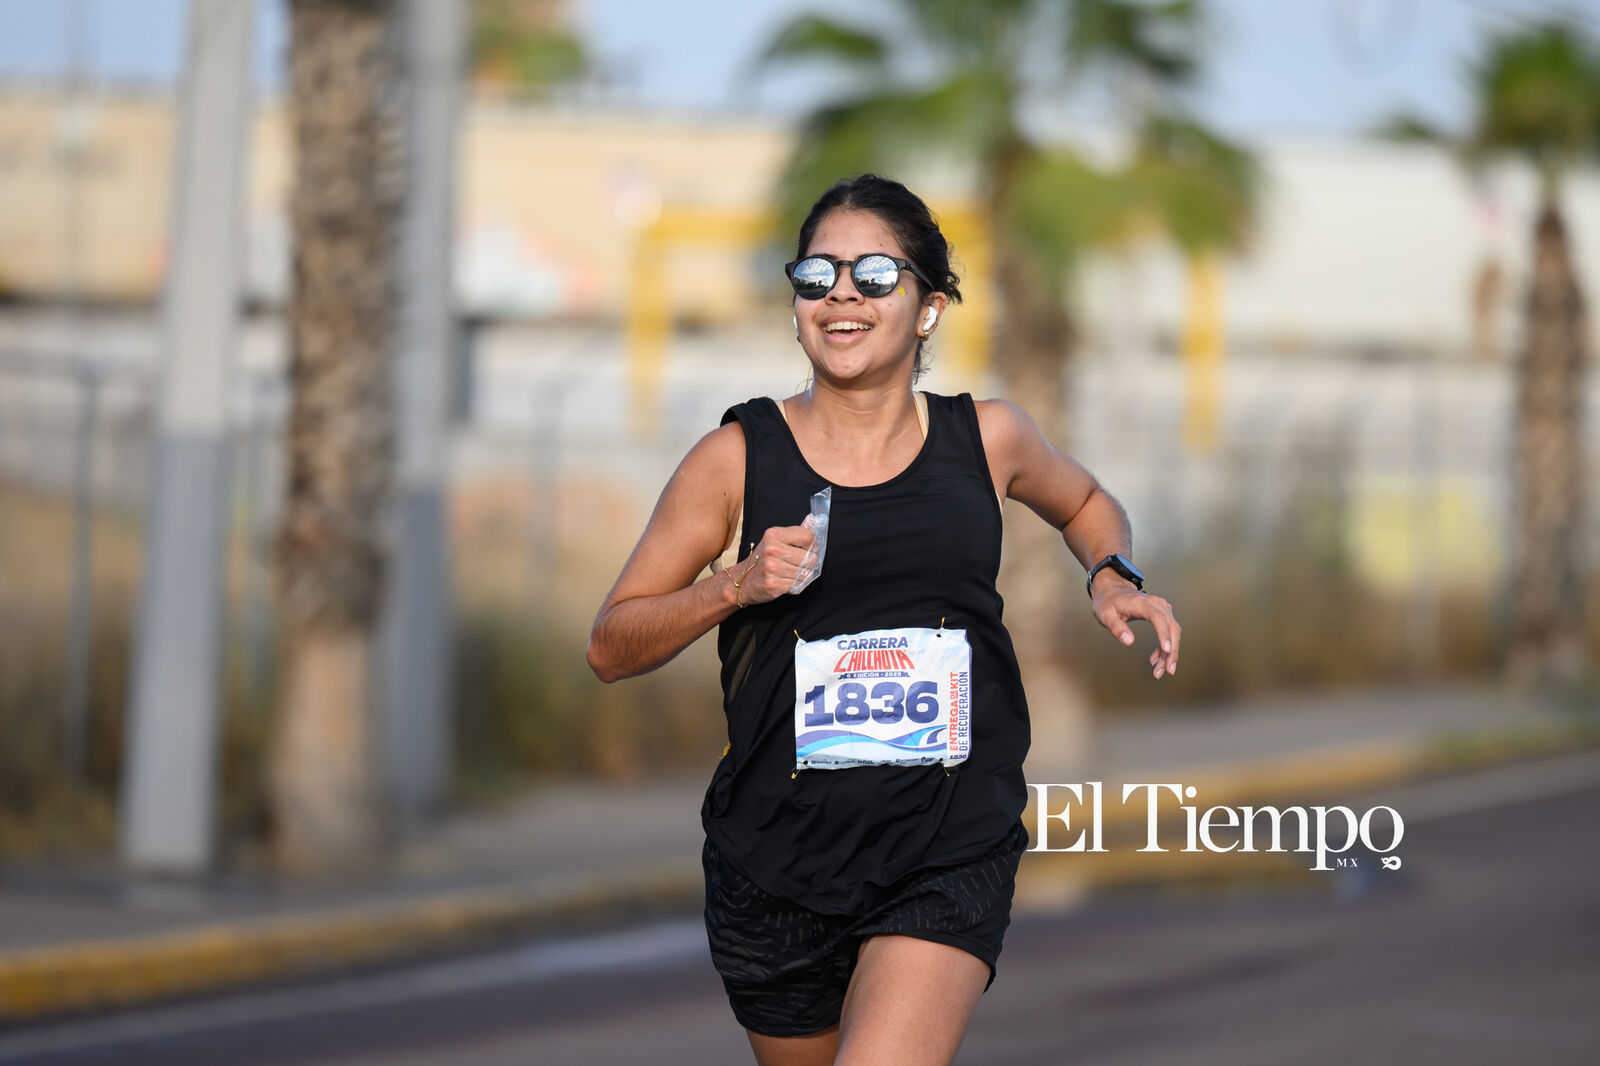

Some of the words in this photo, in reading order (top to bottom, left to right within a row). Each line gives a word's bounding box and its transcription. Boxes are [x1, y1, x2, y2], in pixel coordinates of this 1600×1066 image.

[837, 636, 909, 650] CARRERA
[833, 649, 915, 673] CHILCHOTA
[950, 671, 958, 689] KIT
[804, 680, 940, 728] 1836
[958, 671, 968, 737] RECUPERACIÓN
[949, 700, 958, 751] ENTREGA
[959, 740, 968, 751] DE
